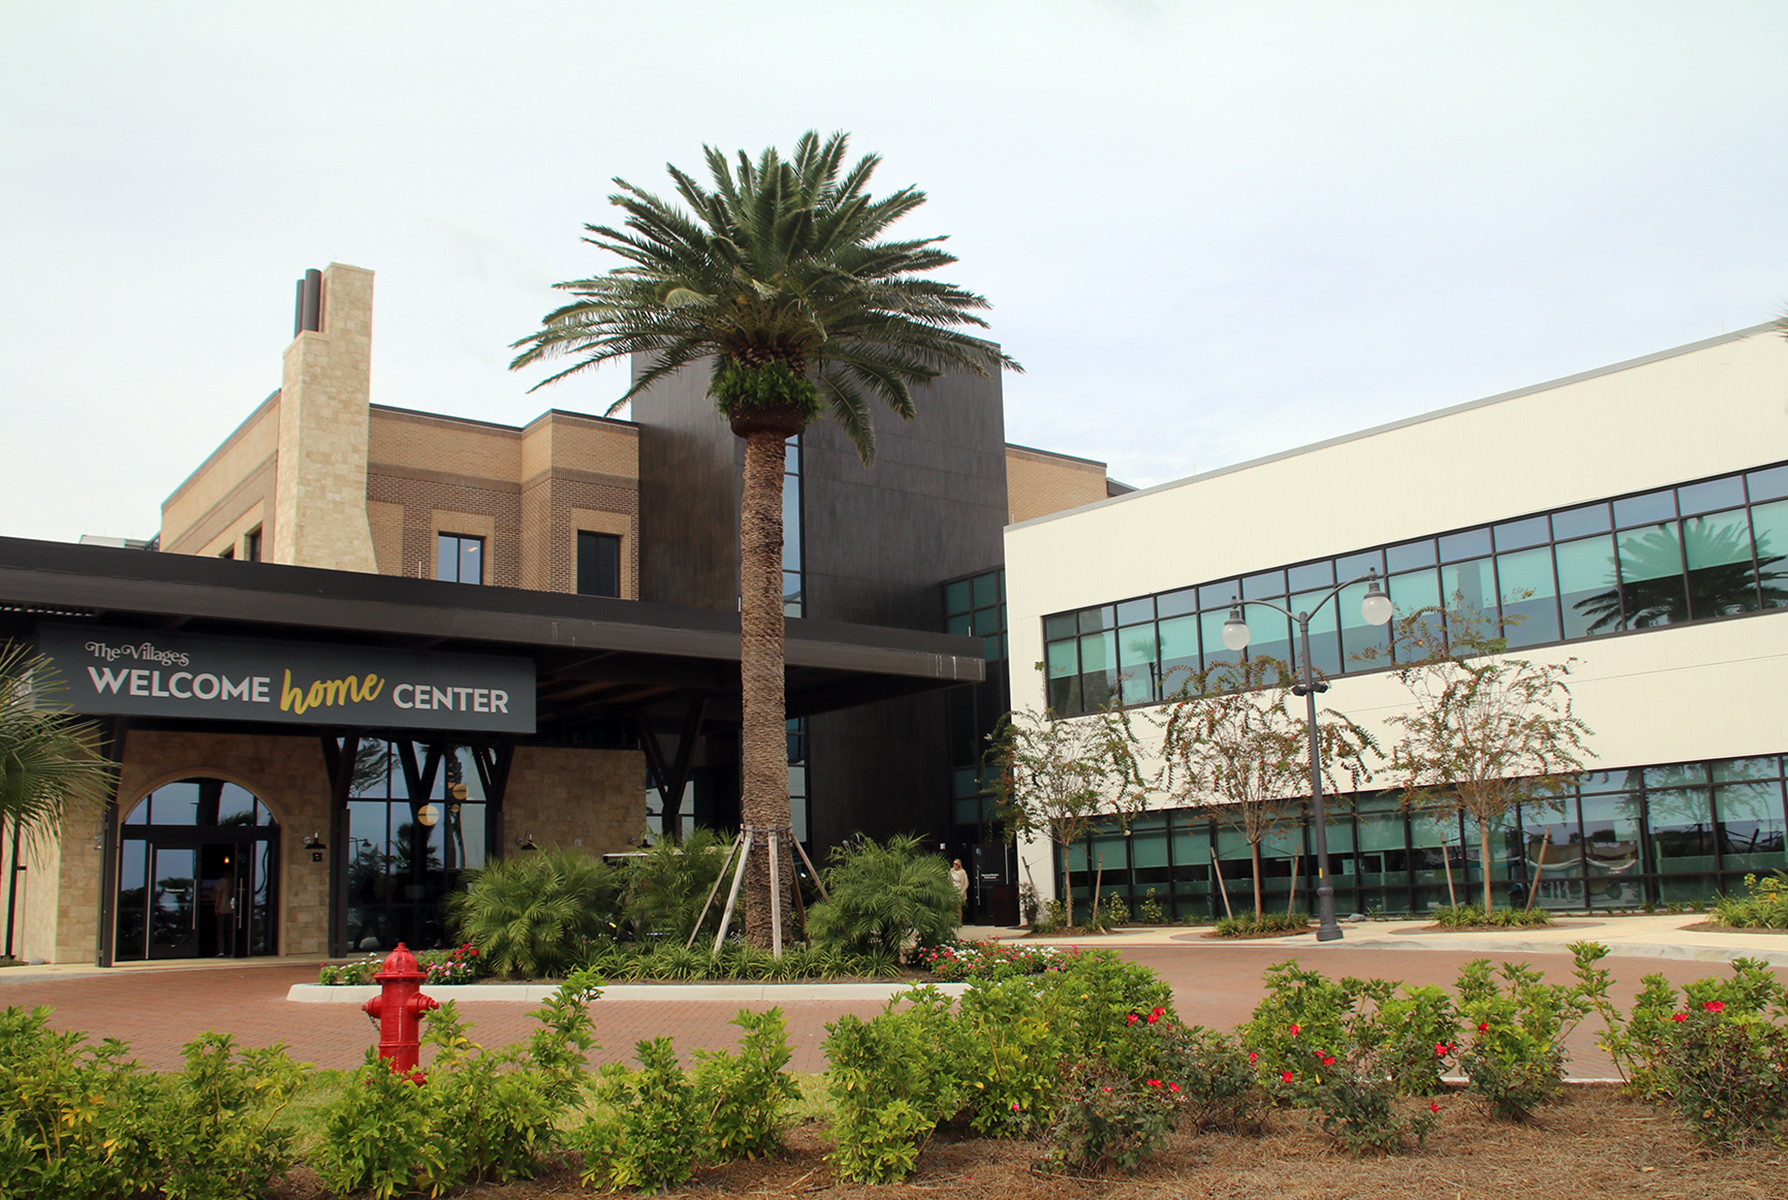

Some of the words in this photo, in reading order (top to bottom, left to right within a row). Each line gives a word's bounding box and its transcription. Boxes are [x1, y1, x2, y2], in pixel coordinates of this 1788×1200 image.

[84, 641, 121, 662] The
[120, 642, 190, 667] Villages
[86, 666, 271, 703] WELCOME
[280, 668, 385, 715] home
[392, 683, 509, 714] CENTER
